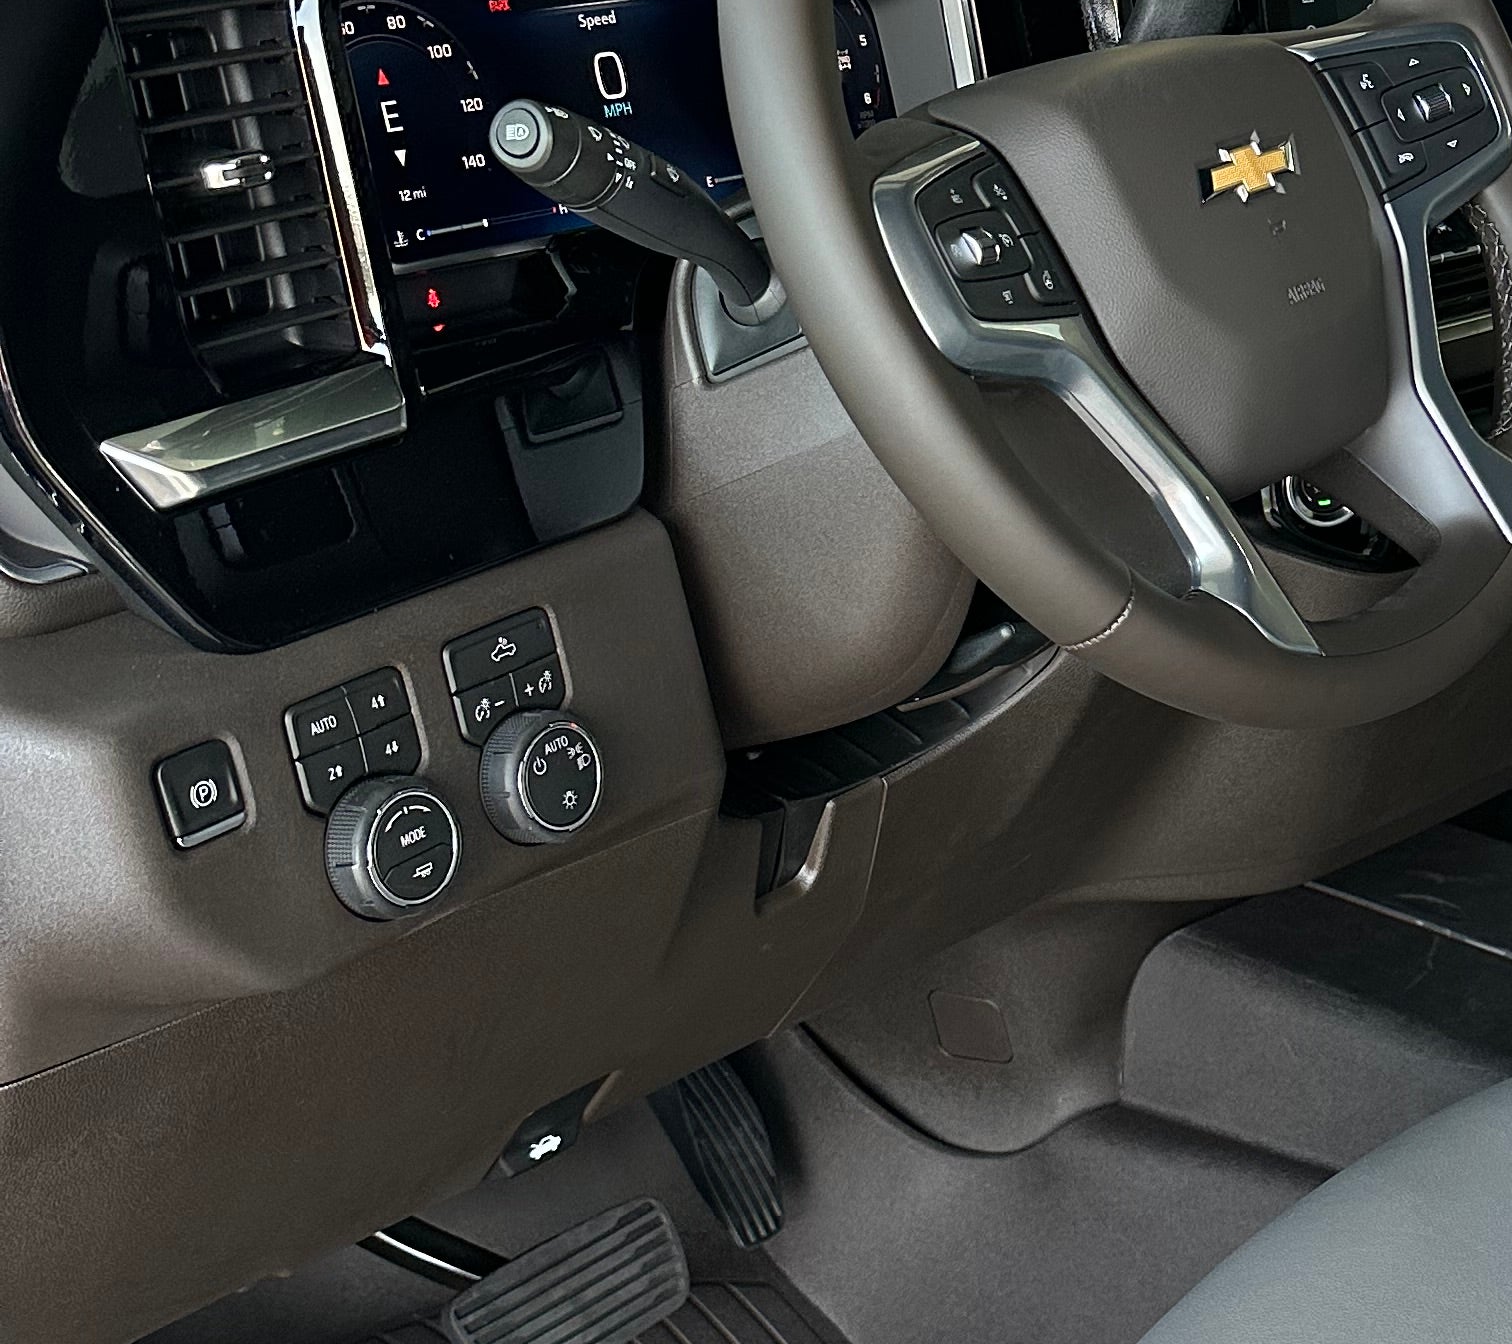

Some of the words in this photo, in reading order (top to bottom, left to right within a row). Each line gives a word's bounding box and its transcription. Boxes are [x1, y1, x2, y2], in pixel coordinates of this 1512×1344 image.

[386, 15, 406, 30] 80
[577, 9, 617, 31] Speed
[859, 34, 867, 46] 5
[427, 44, 452, 59] 100
[593, 51, 627, 100] 0
[460, 97, 484, 112] 120
[863, 92, 872, 104] 6
[380, 100, 404, 133] E
[603, 101, 633, 119] MPH
[461, 153, 486, 169] 140
[705, 175, 715, 188] E
[398, 189, 412, 202] 12
[413, 186, 427, 200] mi
[416, 229, 426, 241] C
[310, 715, 338, 736] AUTO
[544, 735, 569, 756] AUTO
[400, 825, 427, 848] MODE
